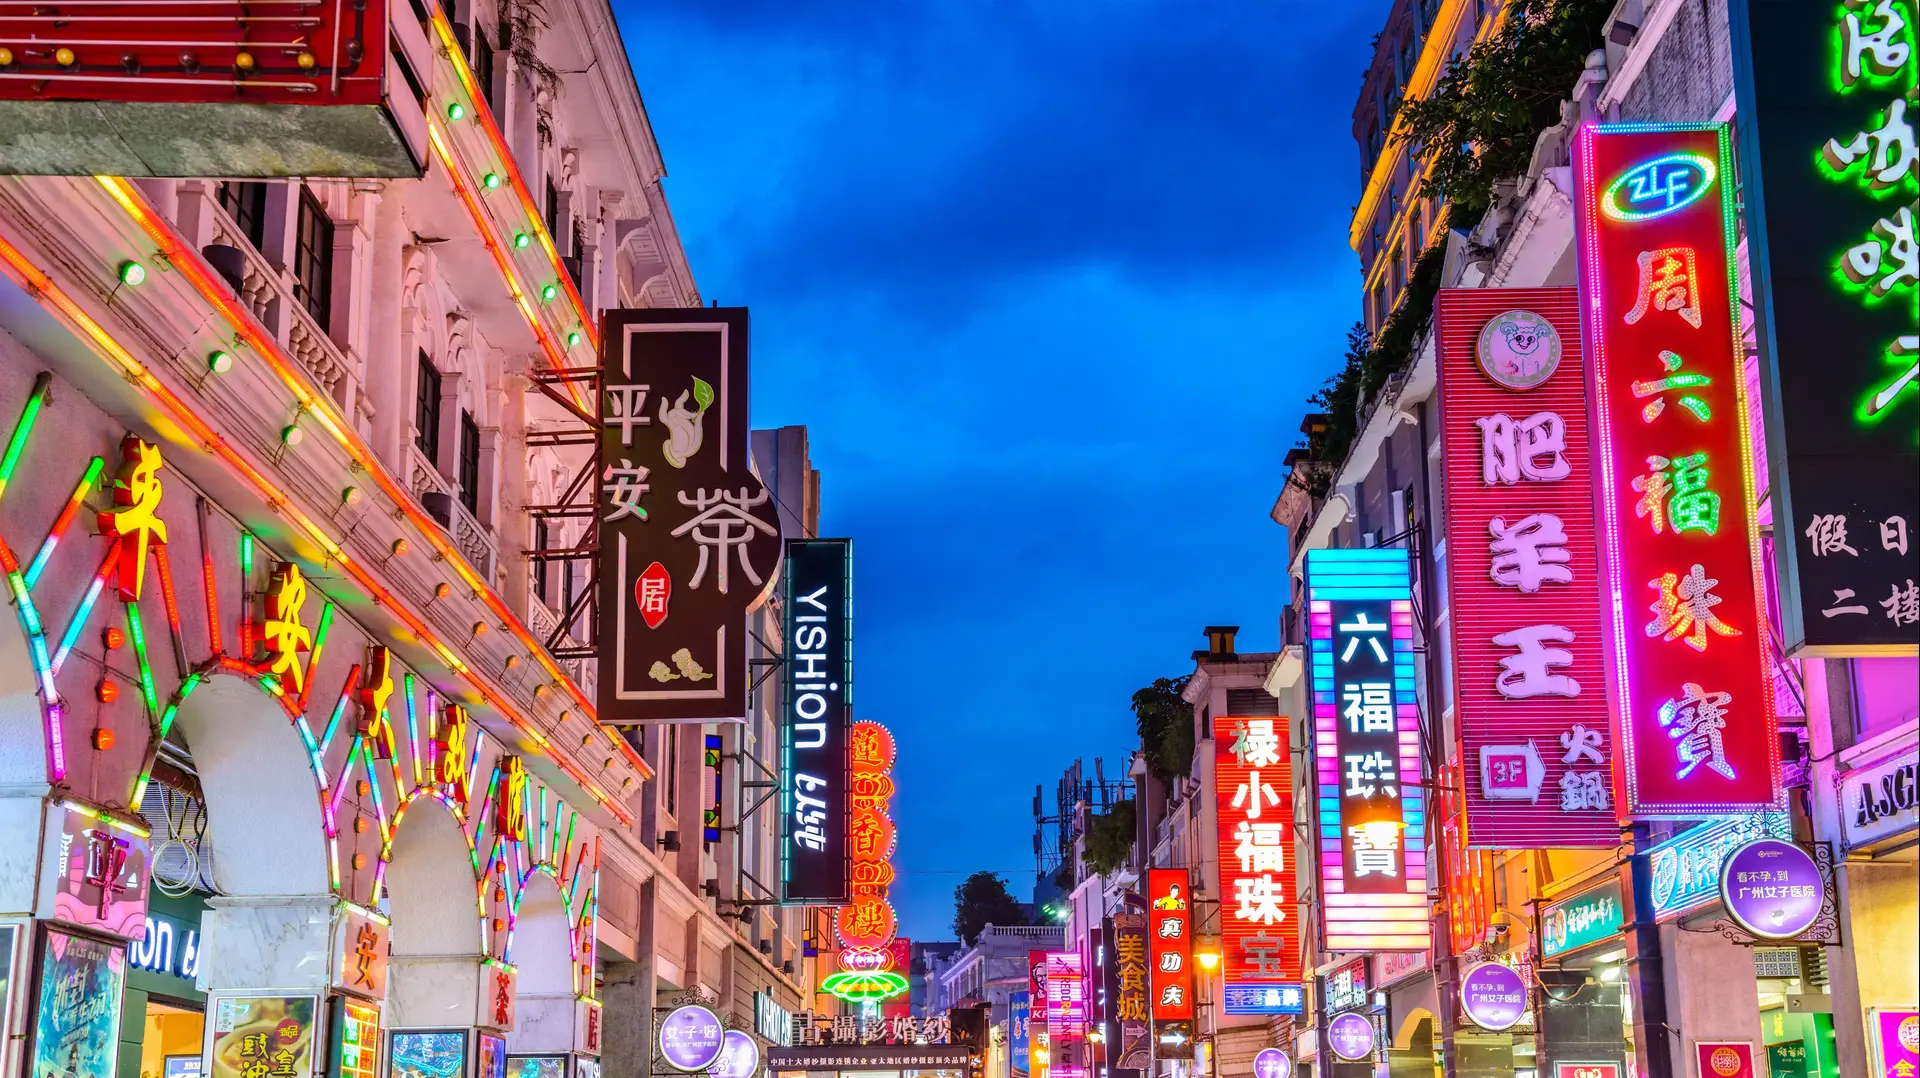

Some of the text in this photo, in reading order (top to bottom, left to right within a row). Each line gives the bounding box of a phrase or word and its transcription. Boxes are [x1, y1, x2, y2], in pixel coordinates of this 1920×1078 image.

[1626, 167, 1690, 208] ZLF
[603, 384, 651, 522] 平安
[670, 487, 778, 594] 茶
[1623, 247, 1743, 781] 周六福珠寶
[1806, 514, 1908, 557] 假日
[1475, 411, 1581, 699] 肥羊王
[640, 577, 666, 613] 居
[1492, 760, 1525, 788] 3F
[1558, 722, 1611, 812] 火鍋
[1230, 719, 1286, 978] 禄小福珠宝
[1739, 886, 1816, 899] 广州女子医院
[355, 922, 379, 990] 安
[1117, 934, 1147, 1021] 美食城
[1159, 918, 1184, 1006] 真功夫
[495, 972, 510, 1025] 茶
[1471, 994, 1521, 1003] 广州女子医院
